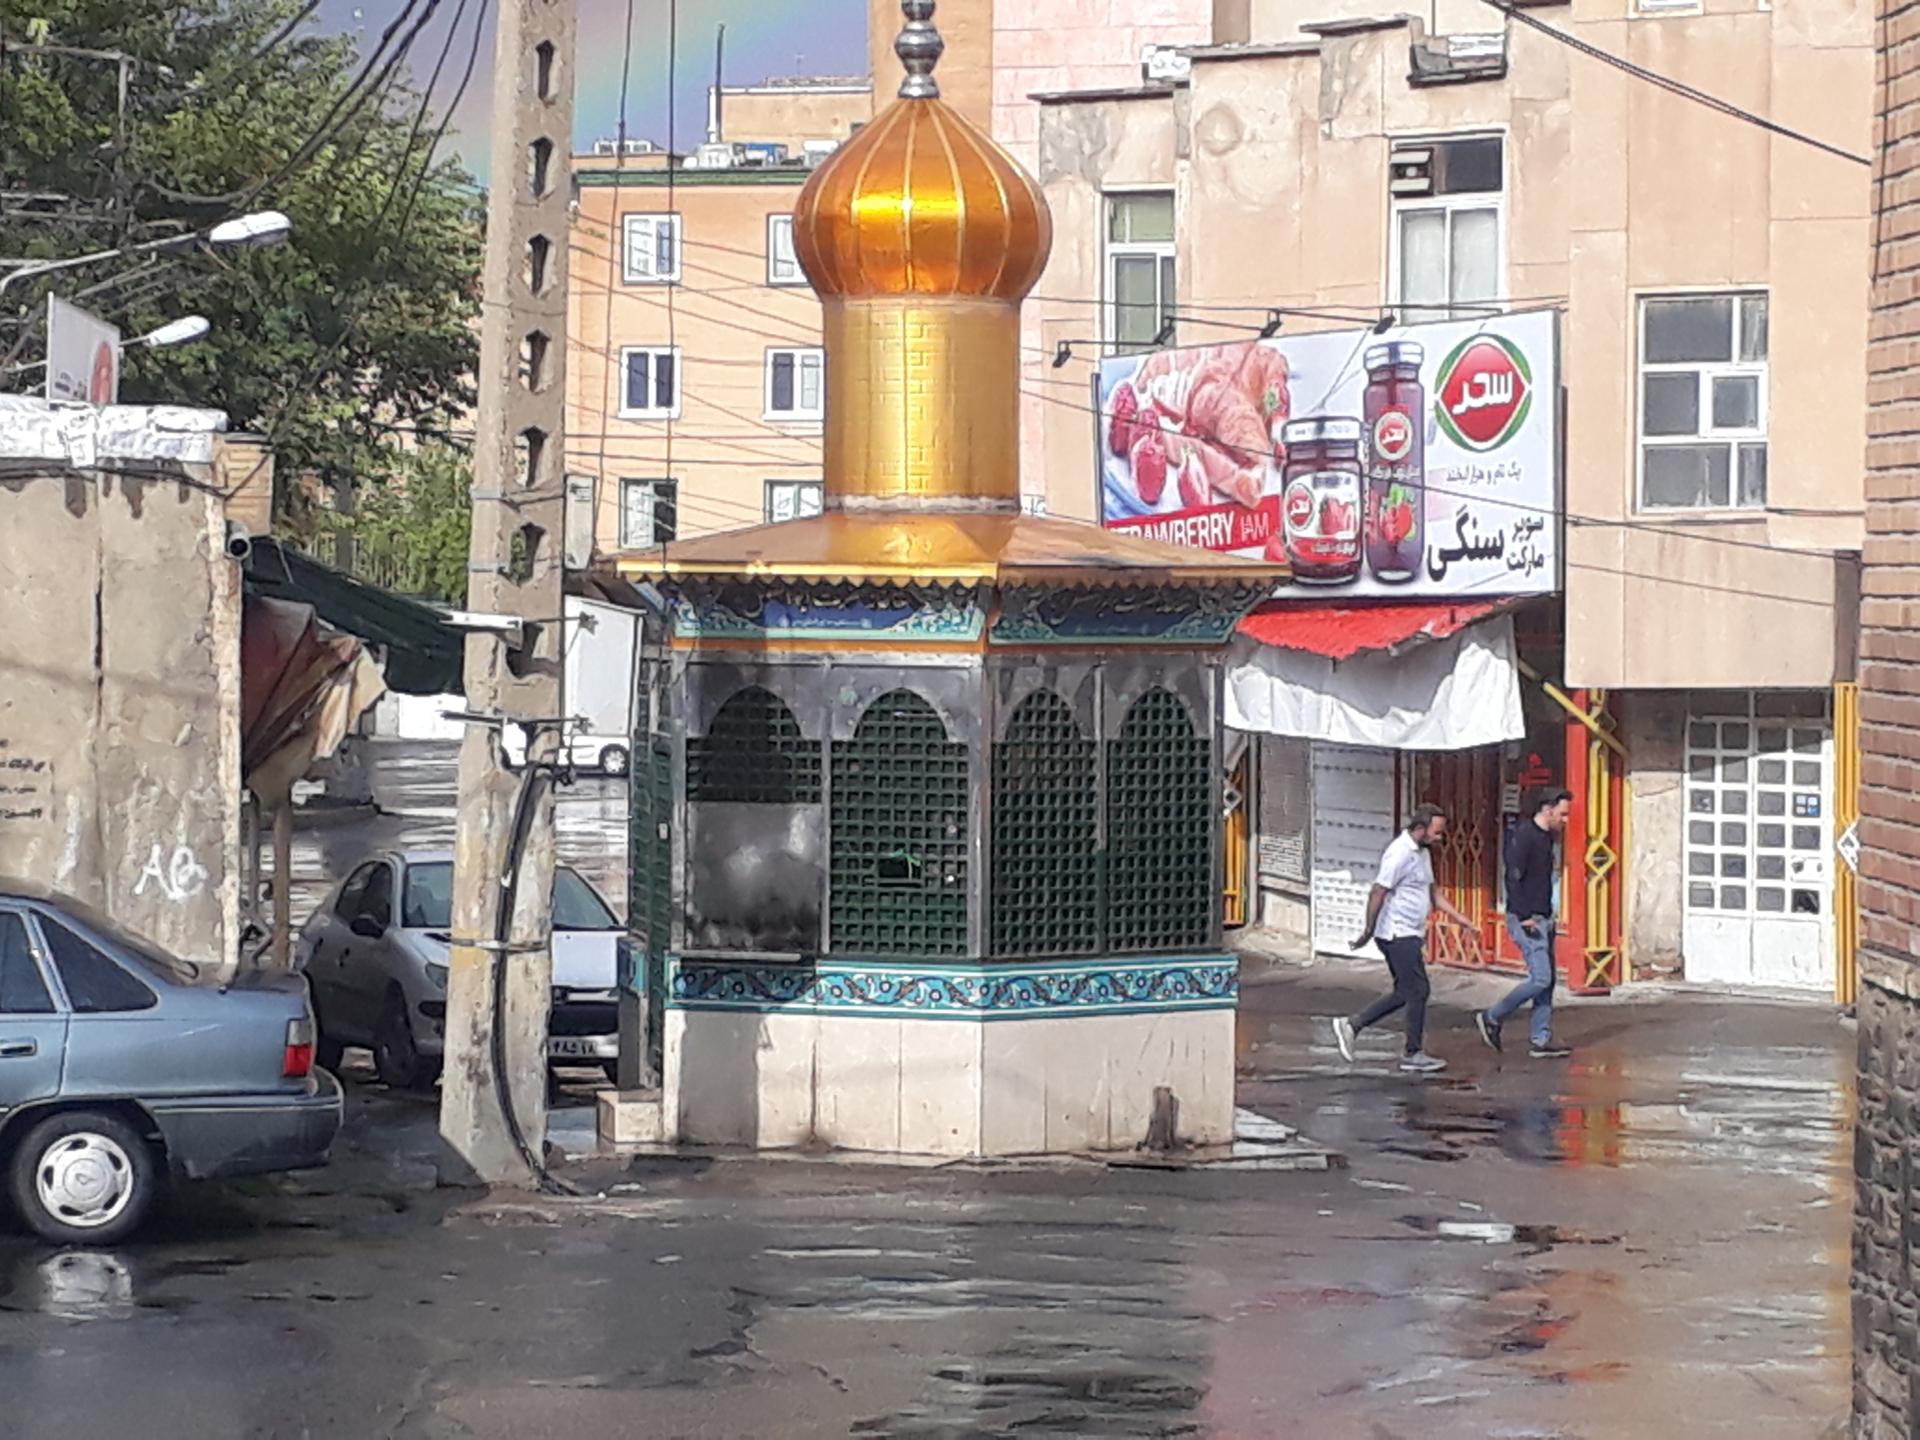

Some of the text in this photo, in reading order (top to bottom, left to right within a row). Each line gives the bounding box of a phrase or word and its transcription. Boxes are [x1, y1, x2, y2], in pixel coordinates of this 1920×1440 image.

[1452, 370, 1513, 415] سحر
[1110, 510, 1235, 549] AWBERRY
[1426, 503, 1505, 582] سنگی
[1512, 516, 1544, 542] سوپر
[1506, 543, 1544, 578] مارکت
